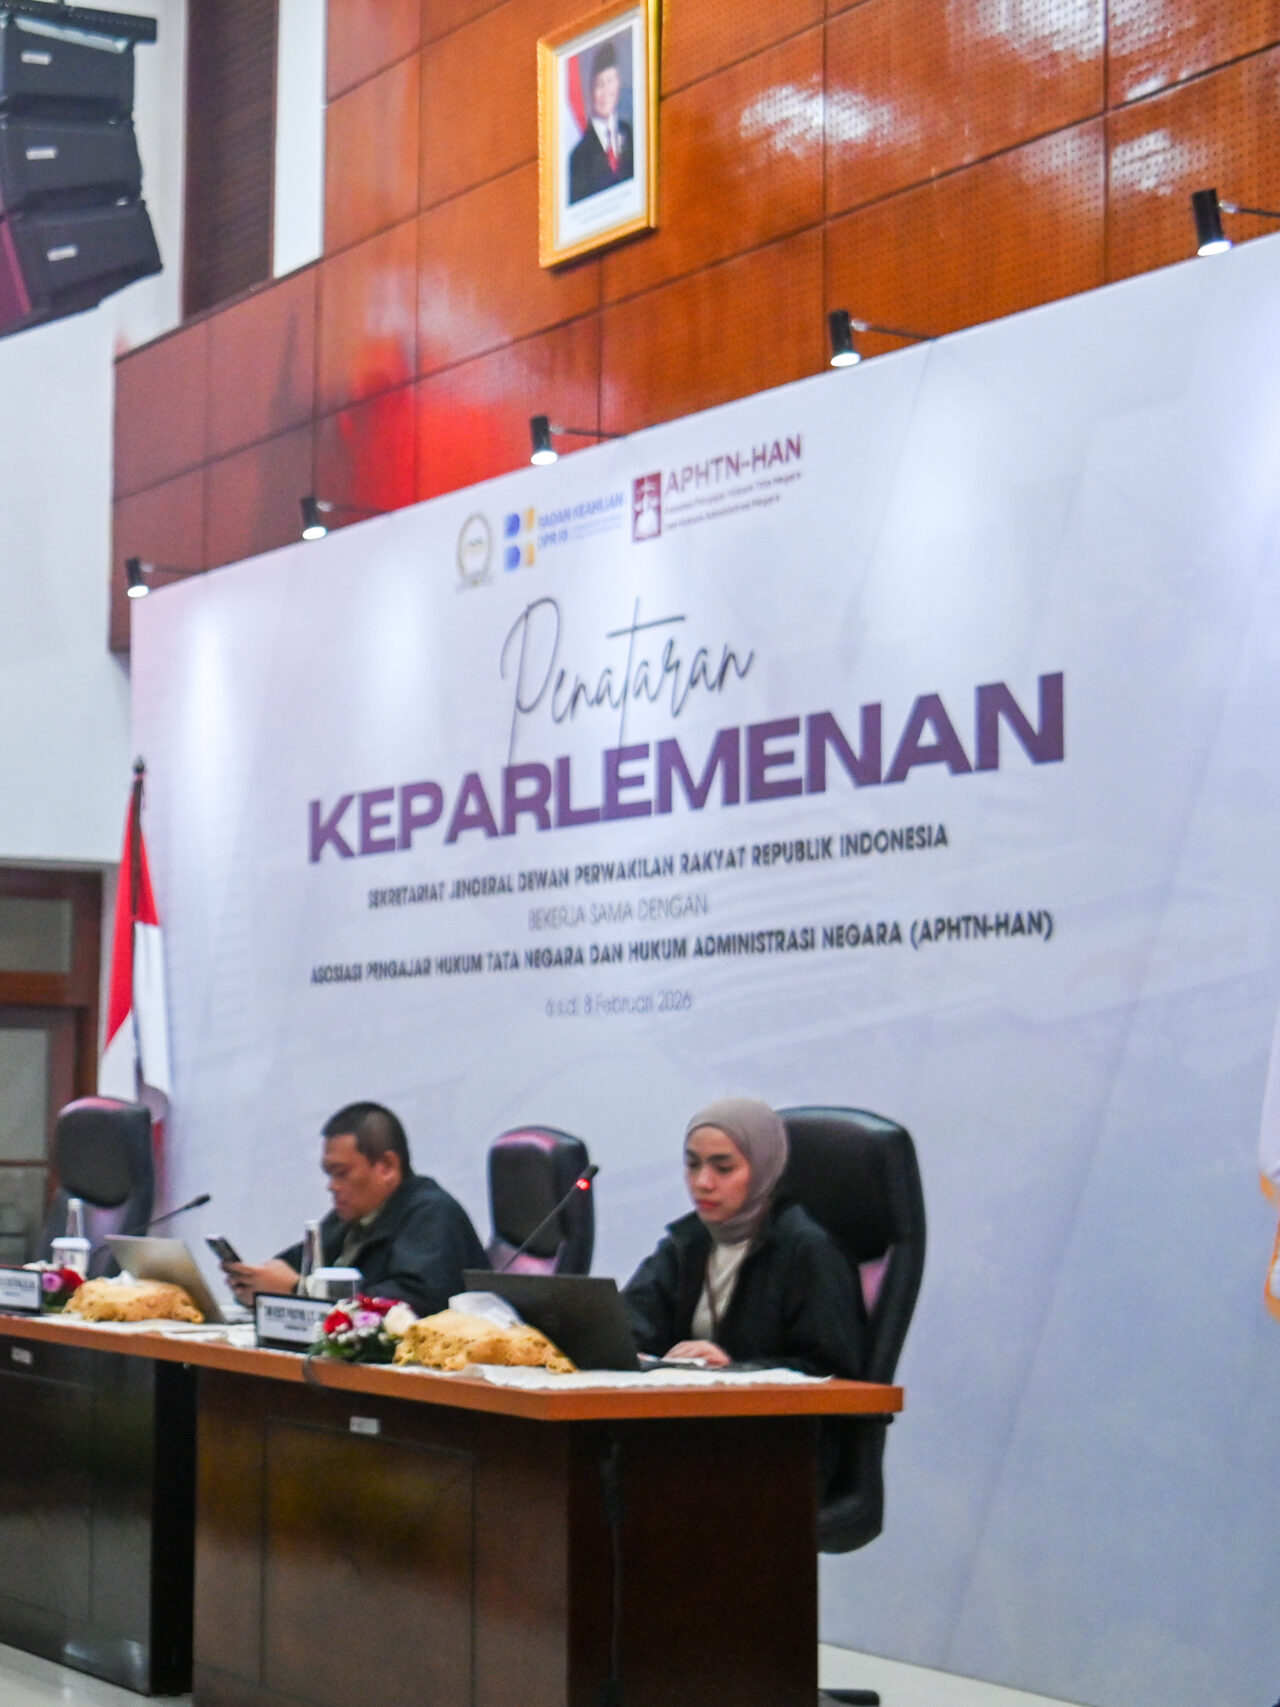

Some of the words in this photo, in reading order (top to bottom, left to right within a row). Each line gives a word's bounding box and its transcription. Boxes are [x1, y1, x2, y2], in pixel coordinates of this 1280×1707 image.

[664, 433, 802, 498] APHTN-HAN
[500, 596, 755, 768] Penataran
[307, 670, 1065, 865] KEPARLEMENAN
[368, 880, 446, 909] SEKRETARIAT
[449, 873, 514, 900] JENDERAL
[519, 865, 570, 891] DEWAN
[574, 854, 675, 886] PERWAKILAN
[680, 846, 747, 875] RAKYAT
[751, 836, 833, 866] REPUBLIK
[840, 823, 950, 859] INDONESIA
[310, 962, 363, 985] ASOSIASI
[366, 958, 432, 981] PENGAJAR
[436, 952, 483, 976] HUKUM
[486, 949, 520, 972] TATA
[524, 944, 585, 970] NEGARA
[589, 941, 622, 965] DAN
[628, 935, 687, 961] HUKUM
[693, 928, 816, 958] ADMINISTRASI
[822, 921, 903, 950] NEGARA
[910, 909, 1054, 951] (APHTN-HAN)
[528, 902, 585, 931] BEKERJA
[589, 900, 634, 925] SAMA
[638, 892, 709, 921] DENGAN
